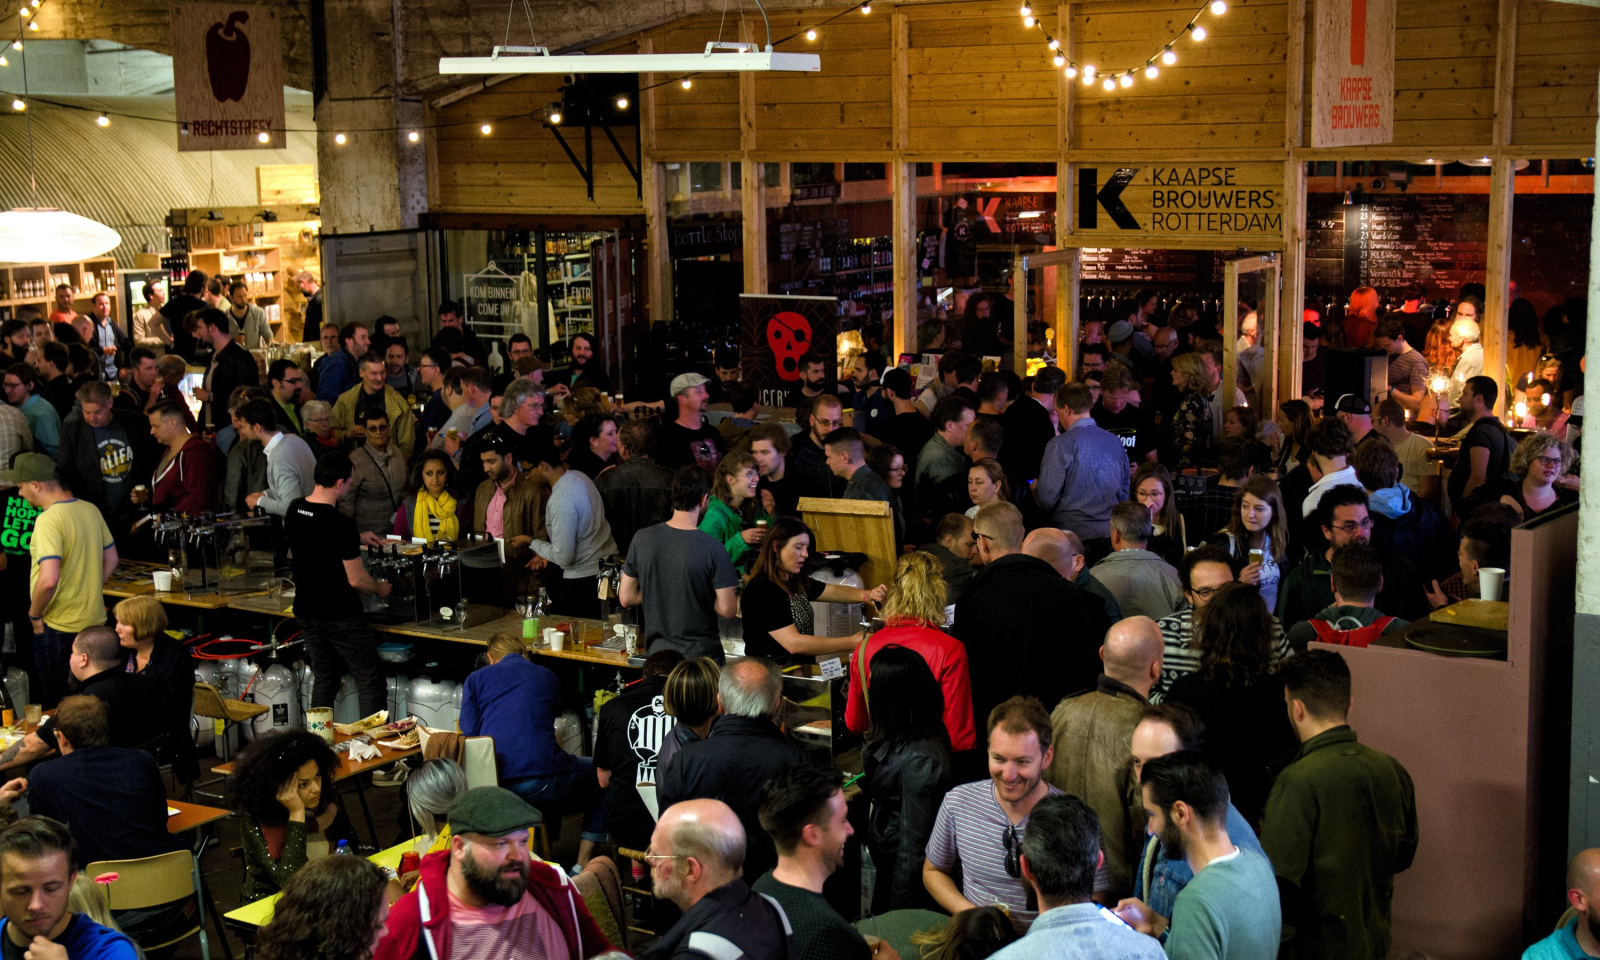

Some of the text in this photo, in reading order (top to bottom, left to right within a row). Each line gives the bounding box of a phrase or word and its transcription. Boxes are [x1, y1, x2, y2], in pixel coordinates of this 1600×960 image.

[1340, 77, 1372, 102] KAAPSE
[1332, 104, 1380, 130] BROUWERS
[1152, 167, 1236, 186] KAAPSE
[1005, 196, 1039, 208] KAAPSE
[1079, 168, 1142, 230] K
[1152, 190, 1274, 209] BROUWERS
[976, 197, 1002, 233] K
[1152, 212, 1282, 231] ROTTERDAM
[1360, 212, 1368, 220] 23
[1006, 222, 1052, 233] ROTTERDAM
[1360, 222, 1368, 230] 24
[1360, 232, 1368, 240] 25
[1360, 241, 1368, 249] 26
[470, 286, 517, 300] KOM BINNEN!
[478, 303, 510, 316] COME IN!
[8, 496, 42, 511] HE
